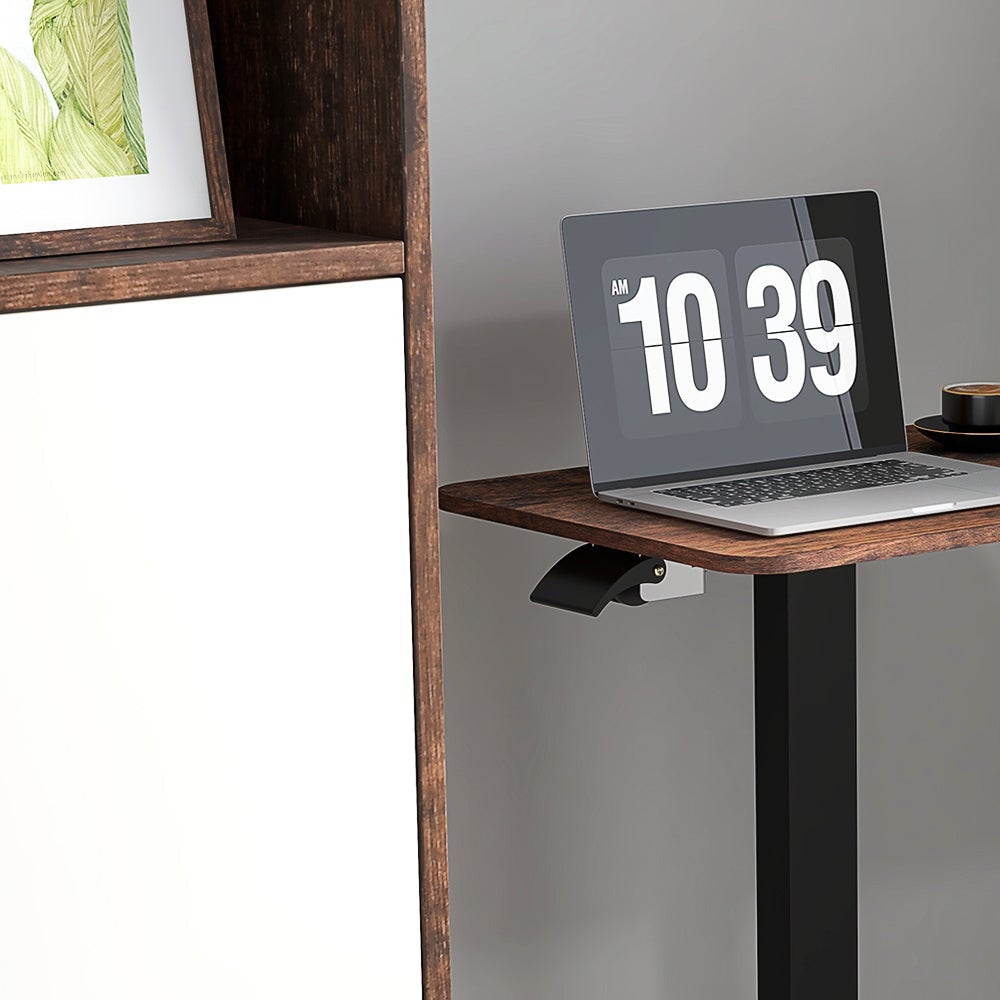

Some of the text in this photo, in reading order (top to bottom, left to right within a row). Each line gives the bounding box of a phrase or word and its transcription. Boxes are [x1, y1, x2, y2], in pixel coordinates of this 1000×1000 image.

[611, 279, 629, 296] AM
[618, 259, 857, 415] 10 39
